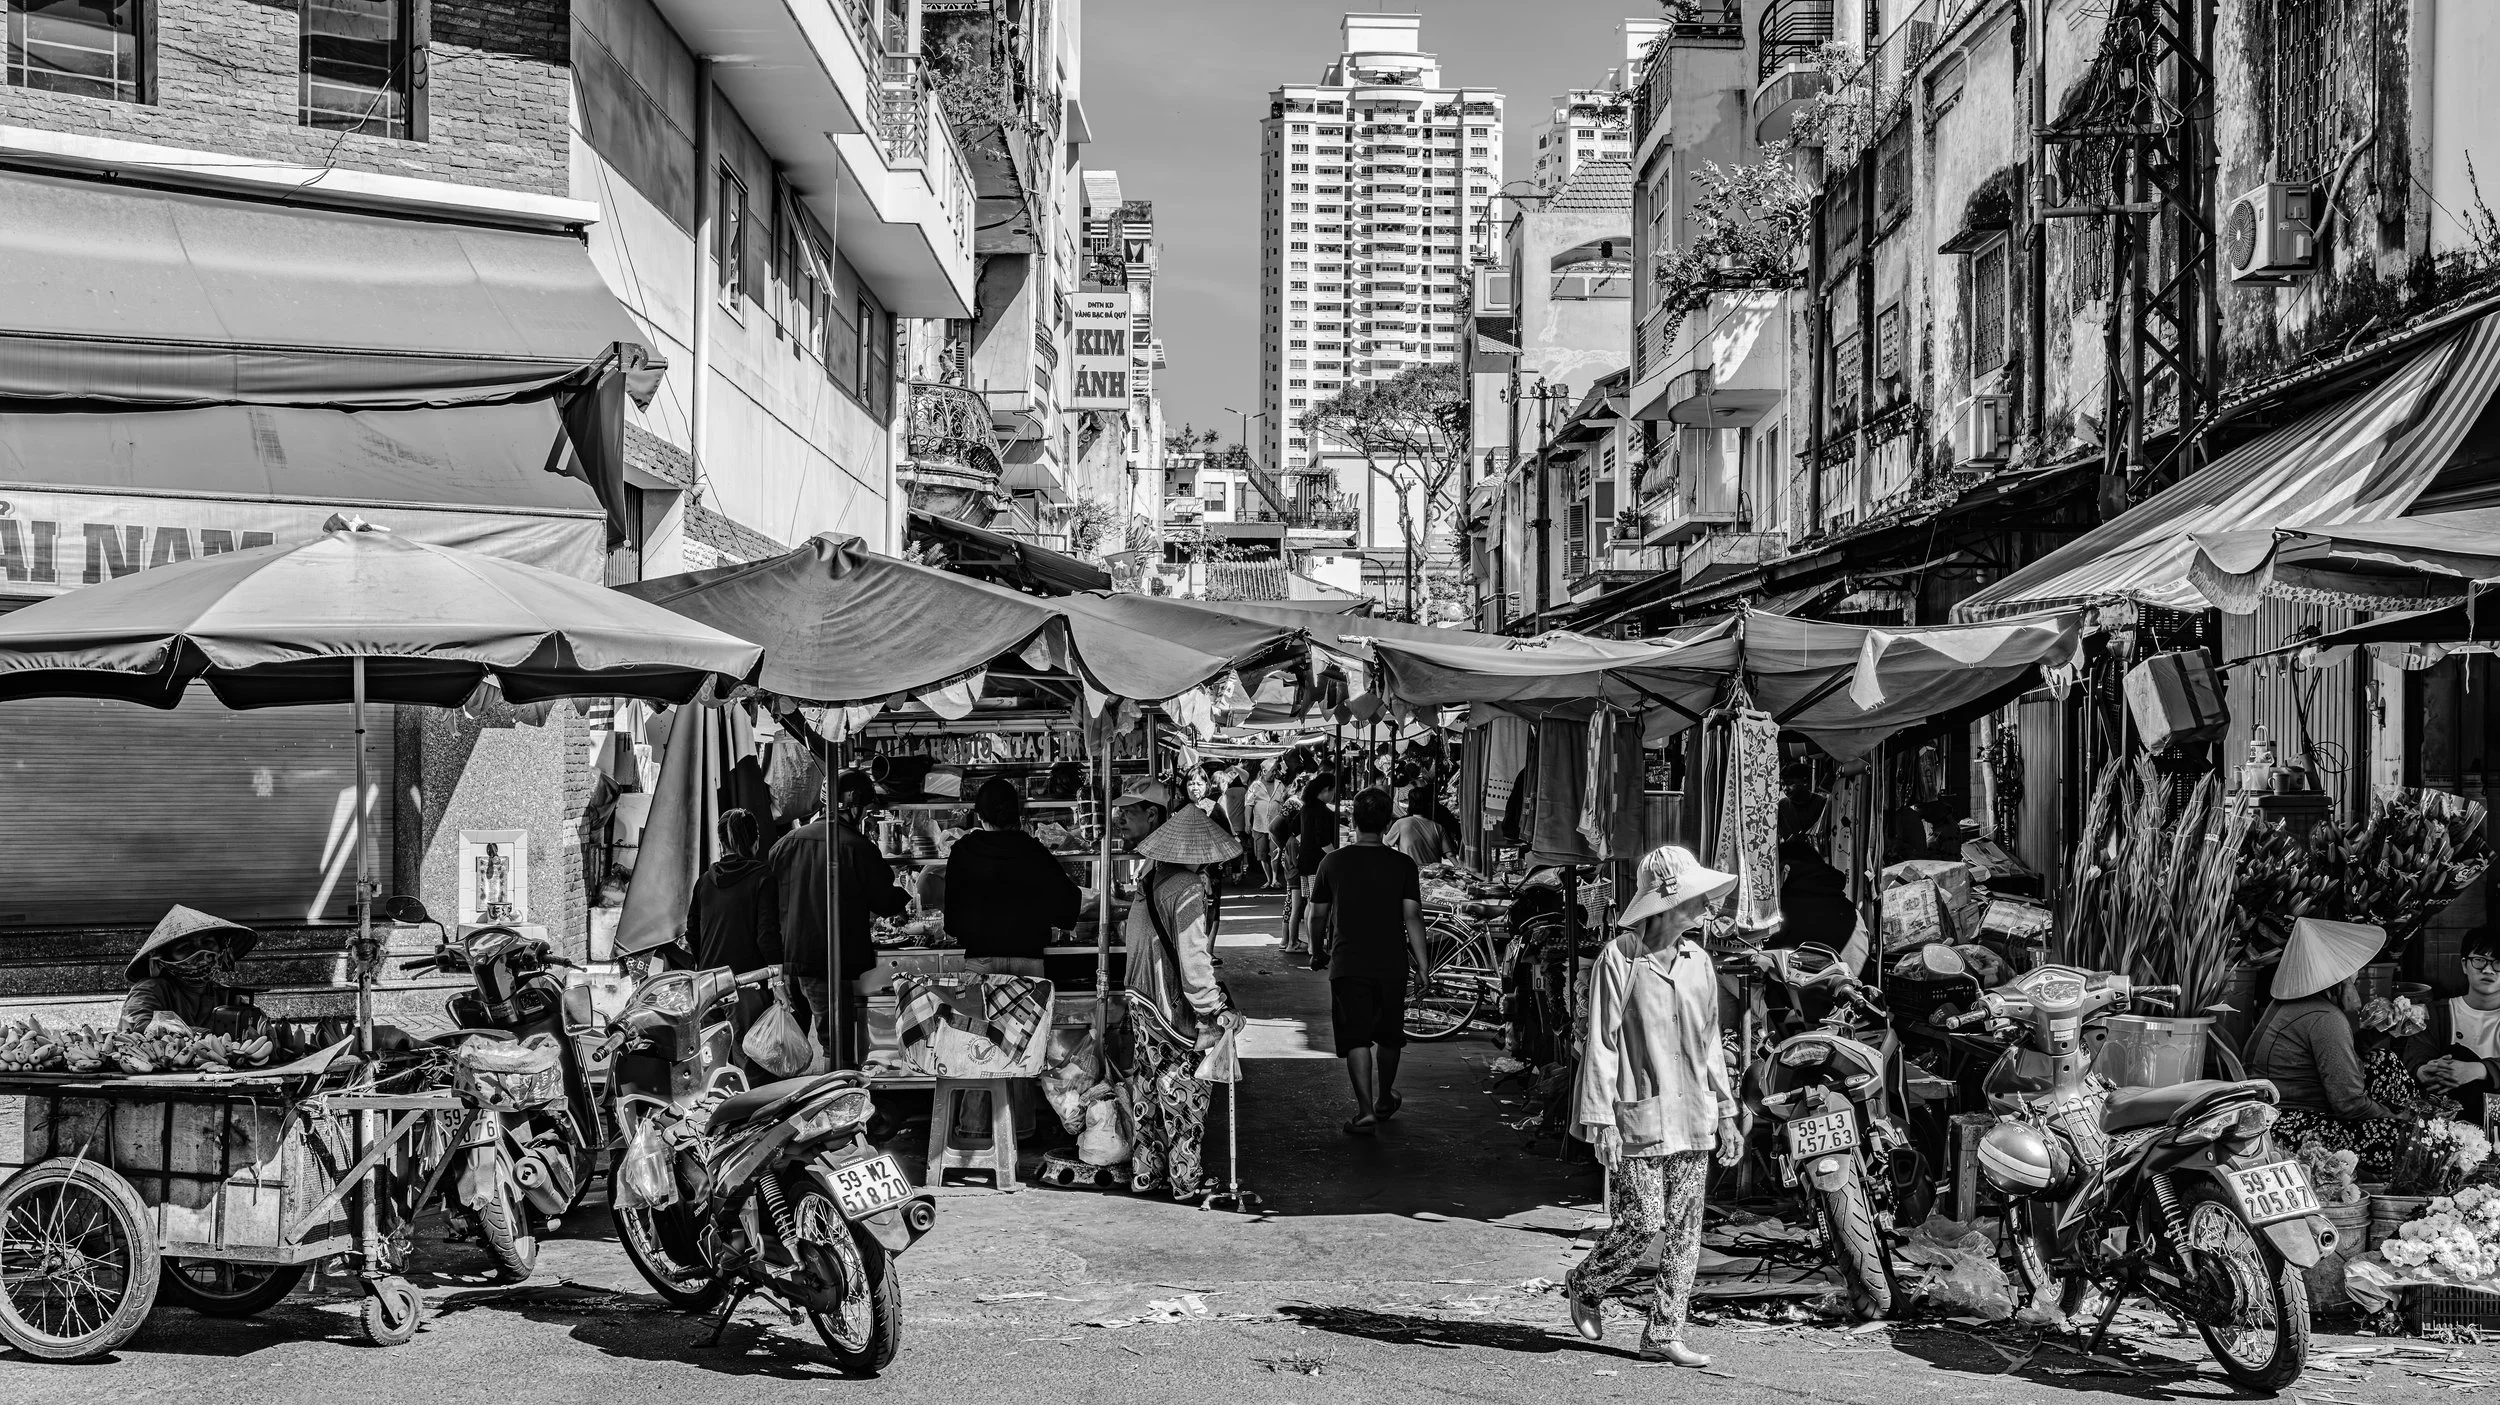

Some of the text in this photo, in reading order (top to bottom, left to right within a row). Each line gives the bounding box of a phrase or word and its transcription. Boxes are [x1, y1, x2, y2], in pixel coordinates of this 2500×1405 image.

[1074, 310, 1091, 319] VÀNG
[1092, 311, 1104, 319] BẠC
[1113, 310, 1127, 320] QUÝ
[1087, 301, 1114, 309] DNTN KD
[1075, 329, 1125, 356] KIM
[1074, 364, 1126, 398] ÁNH
[1798, 1114, 1845, 1137] 59-L3
[1797, 1129, 1853, 1154] 457.63
[837, 1161, 891, 1191] 59-M2
[841, 1178, 908, 1213] 518.20
[2245, 1186, 2310, 1218] 205.87
